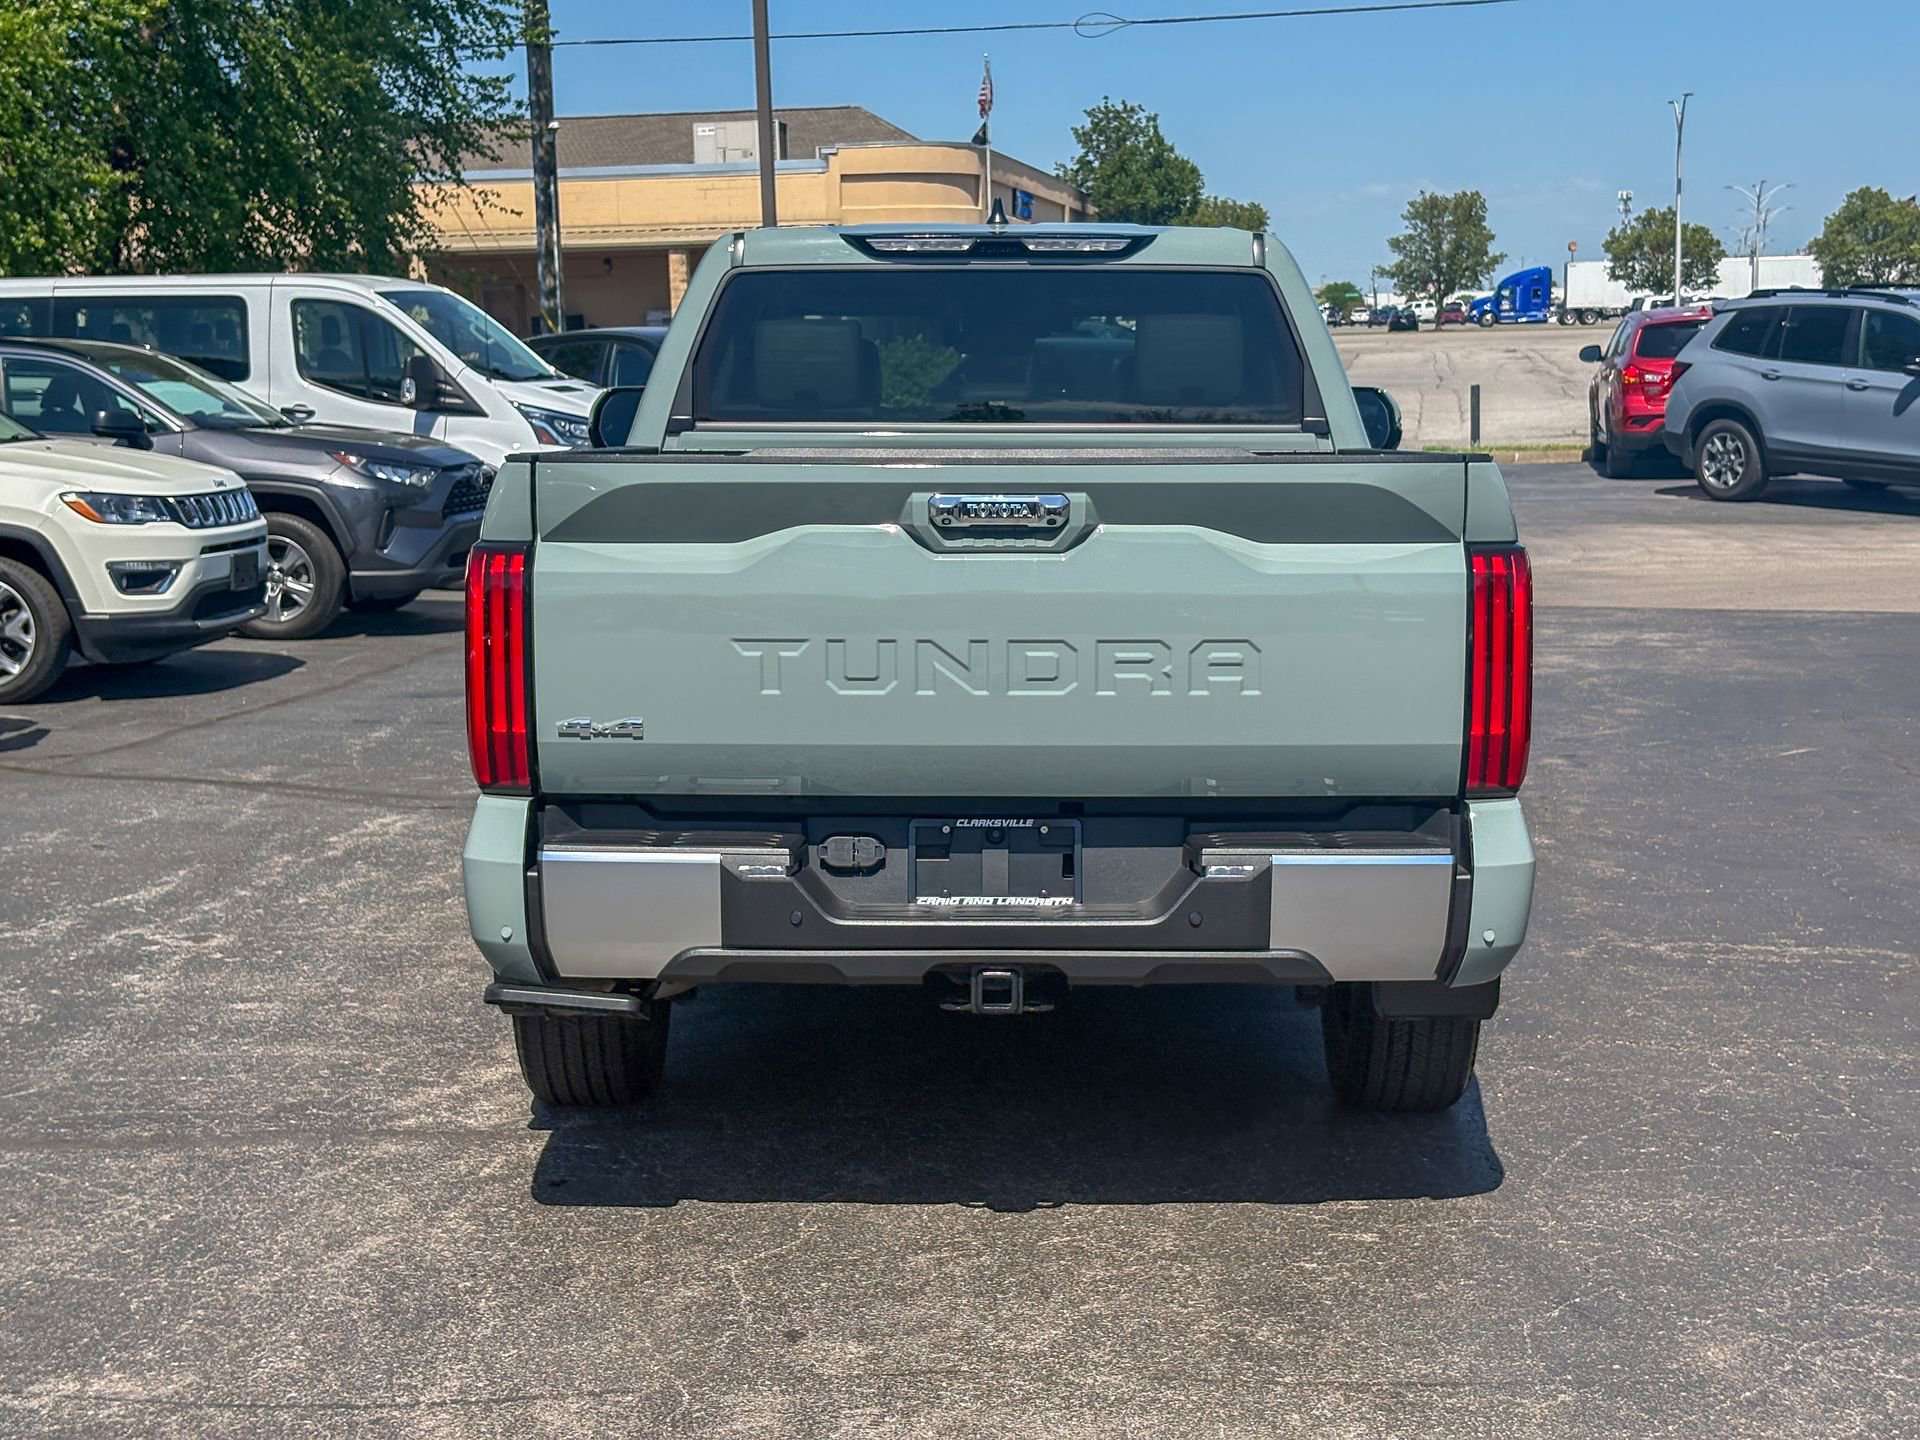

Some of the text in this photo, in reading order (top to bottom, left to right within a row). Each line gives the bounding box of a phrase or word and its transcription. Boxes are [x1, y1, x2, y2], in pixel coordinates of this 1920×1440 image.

[967, 503, 1031, 518] TOYOTA
[731, 638, 1262, 696] TUNDRA
[956, 818, 1035, 827] CLARKSVILLE
[961, 896, 995, 905] AND
[997, 896, 1075, 906] LANDRETH
